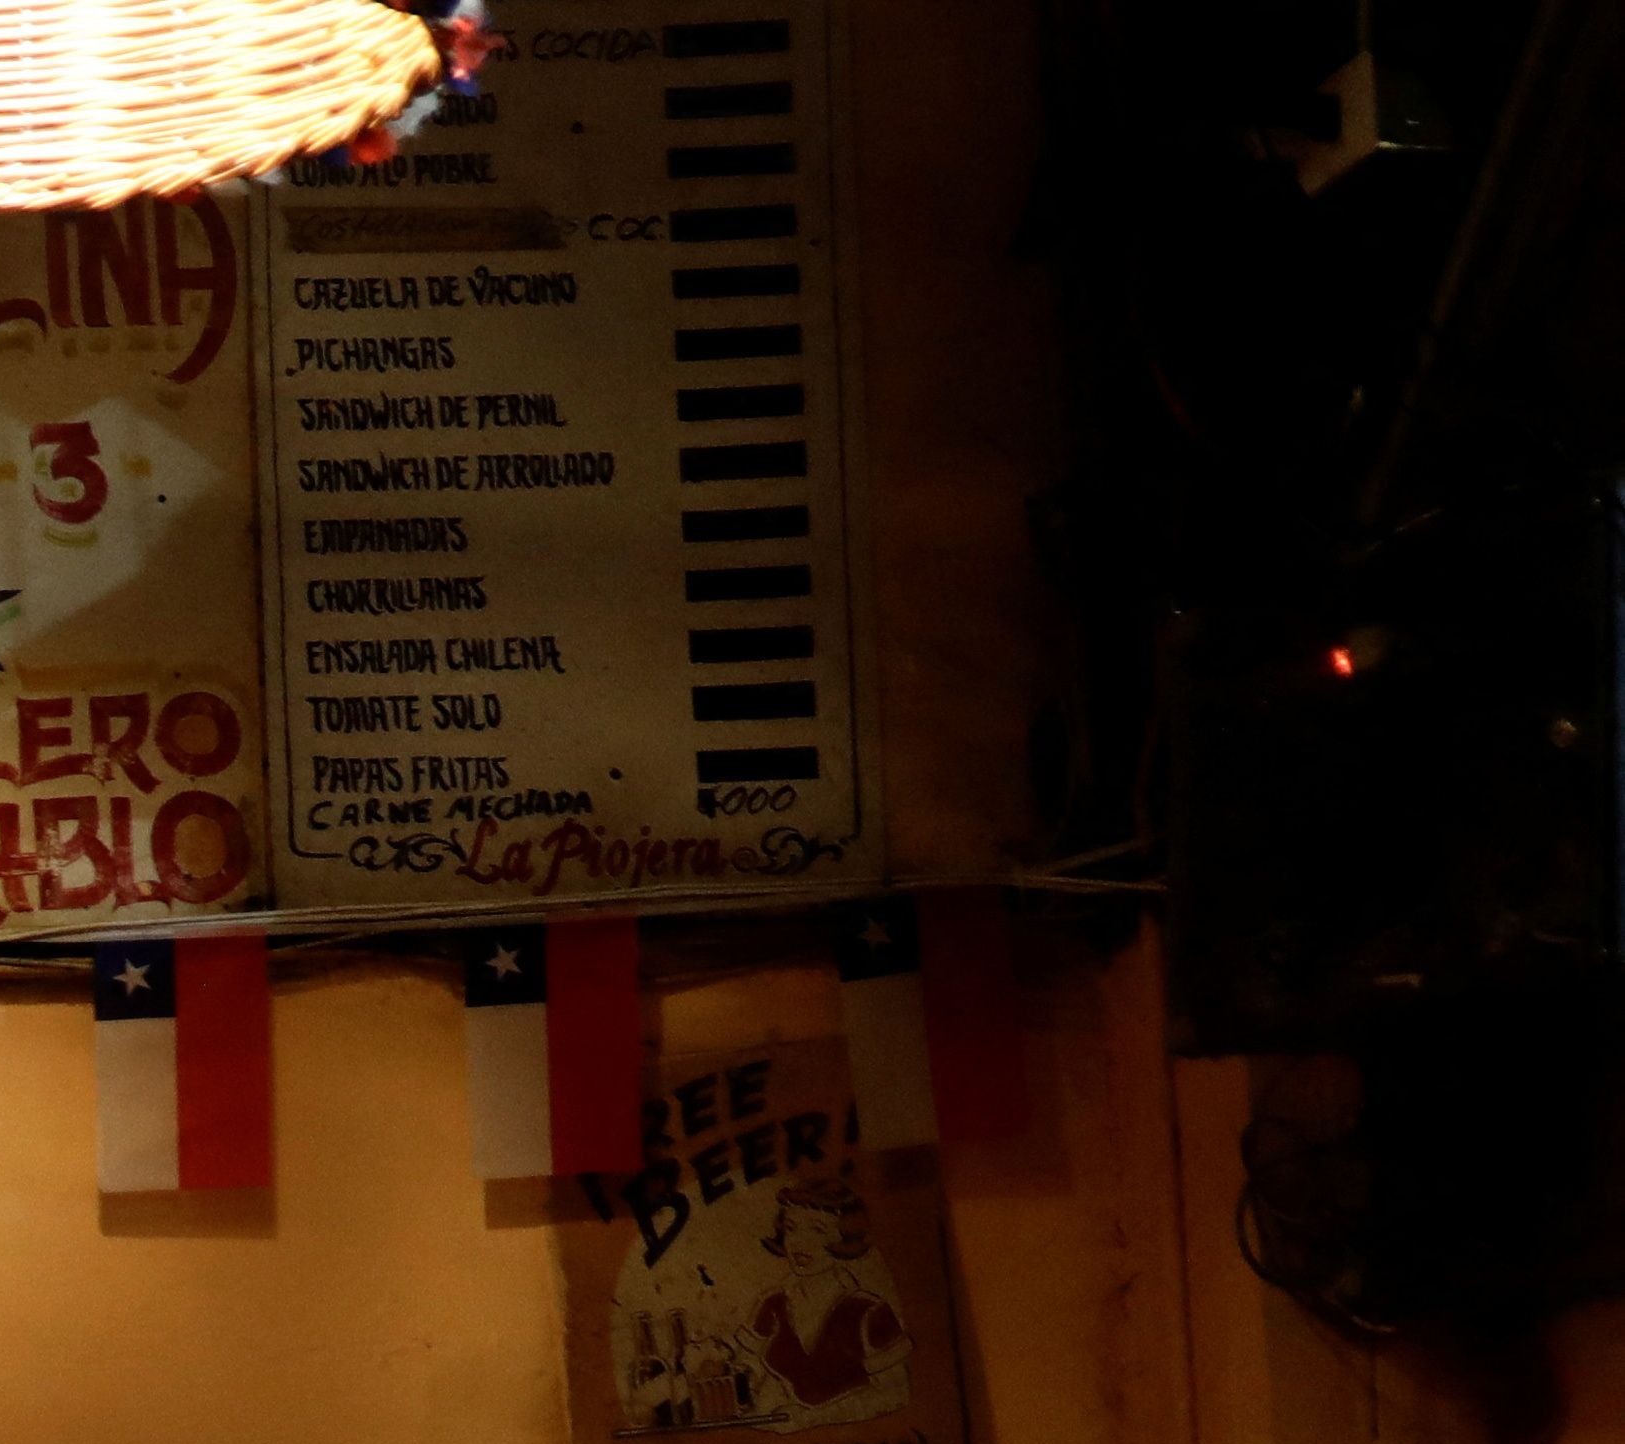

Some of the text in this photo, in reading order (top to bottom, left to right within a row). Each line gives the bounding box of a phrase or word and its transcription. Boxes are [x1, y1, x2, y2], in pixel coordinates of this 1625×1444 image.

[413, 152, 498, 186] POBRE
[293, 265, 578, 311] CAZUELA DE VACUNO
[294, 335, 455, 374] PICHANGAS
[297, 389, 568, 431] SANDWICH DE PERNIL
[30, 421, 109, 525] 3
[298, 450, 615, 493] SANDWICH DE ARROLLADO
[303, 516, 468, 555] EMPANADAS
[307, 576, 489, 615] CHORRILLANAS
[305, 635, 566, 674] ENSALADA CHILENA
[306, 692, 503, 734] TOMATE SOLO
[312, 754, 511, 793] PAPAS FRITAS
[307, 797, 434, 831] CARNE
[443, 788, 593, 823] MECHADA
[455, 817, 729, 896] La Piojera
